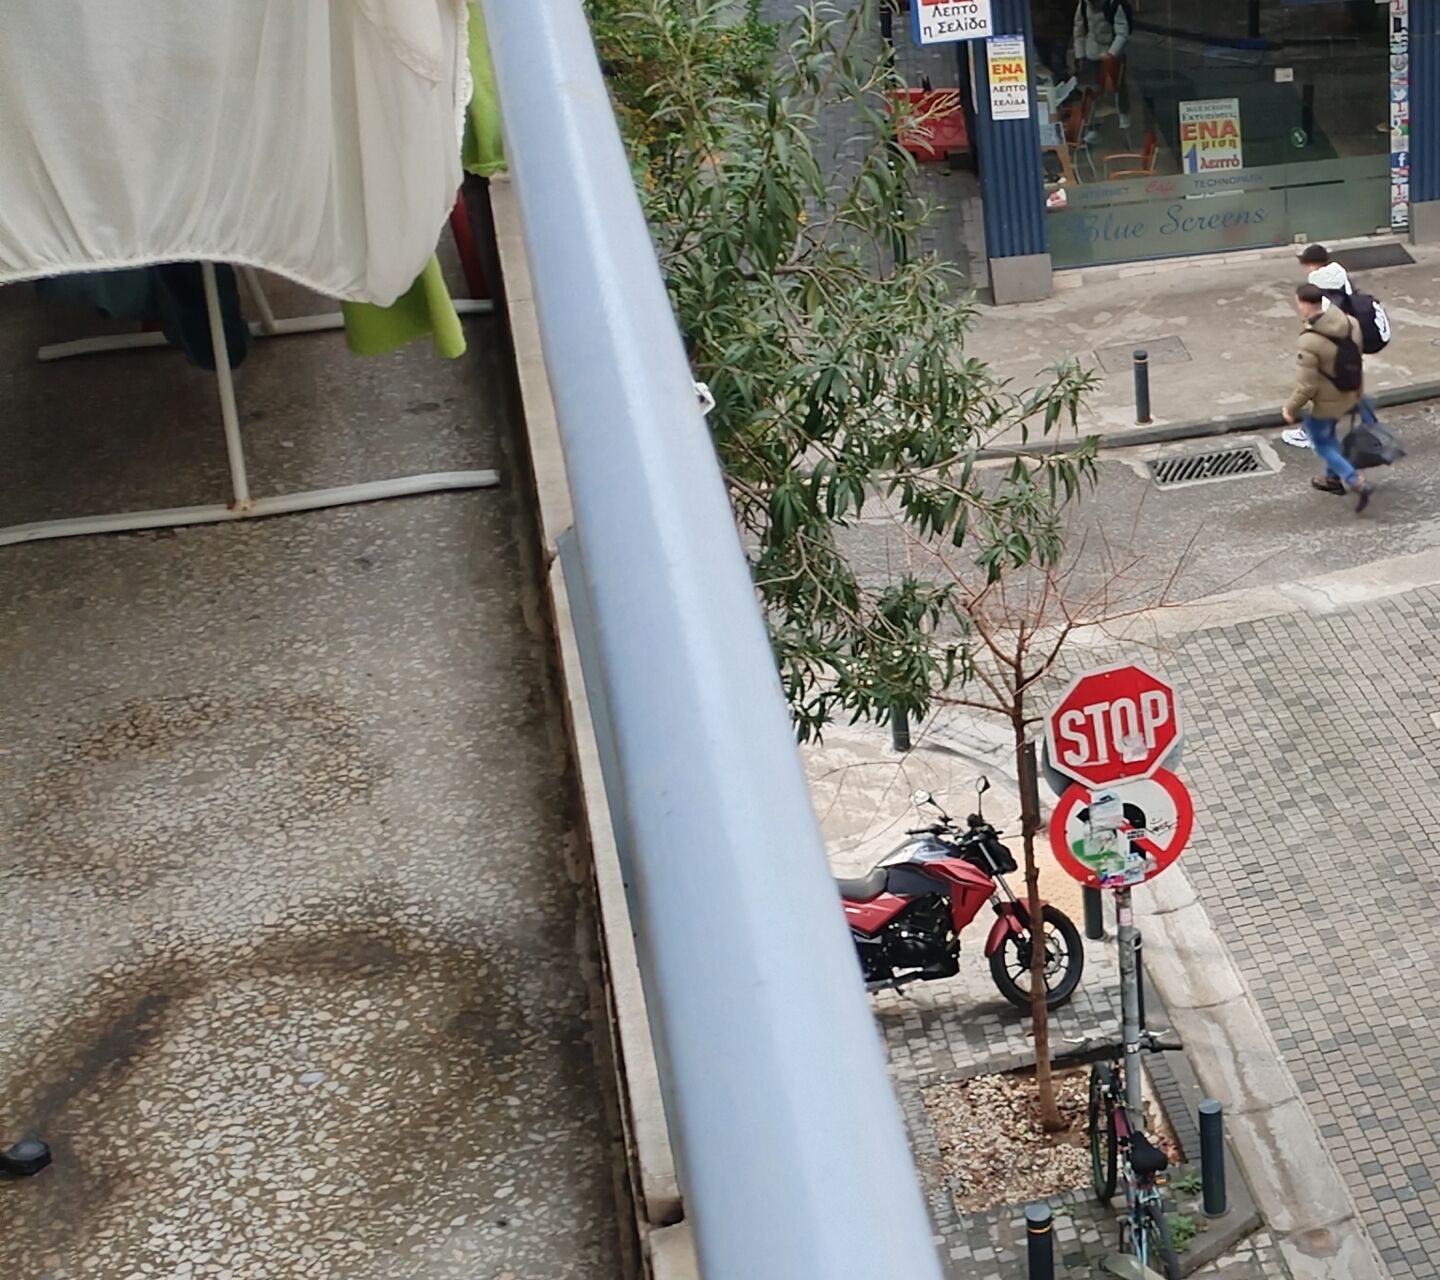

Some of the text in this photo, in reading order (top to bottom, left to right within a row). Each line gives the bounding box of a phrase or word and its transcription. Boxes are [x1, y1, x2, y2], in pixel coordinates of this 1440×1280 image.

[923, 26, 933, 38] η
[992, 63, 1024, 75] ΕΝΑ
[1182, 119, 1239, 141] ΕΝΑ
[1160, 205, 1269, 235] Screens
[1059, 690, 1169, 767] STOP
